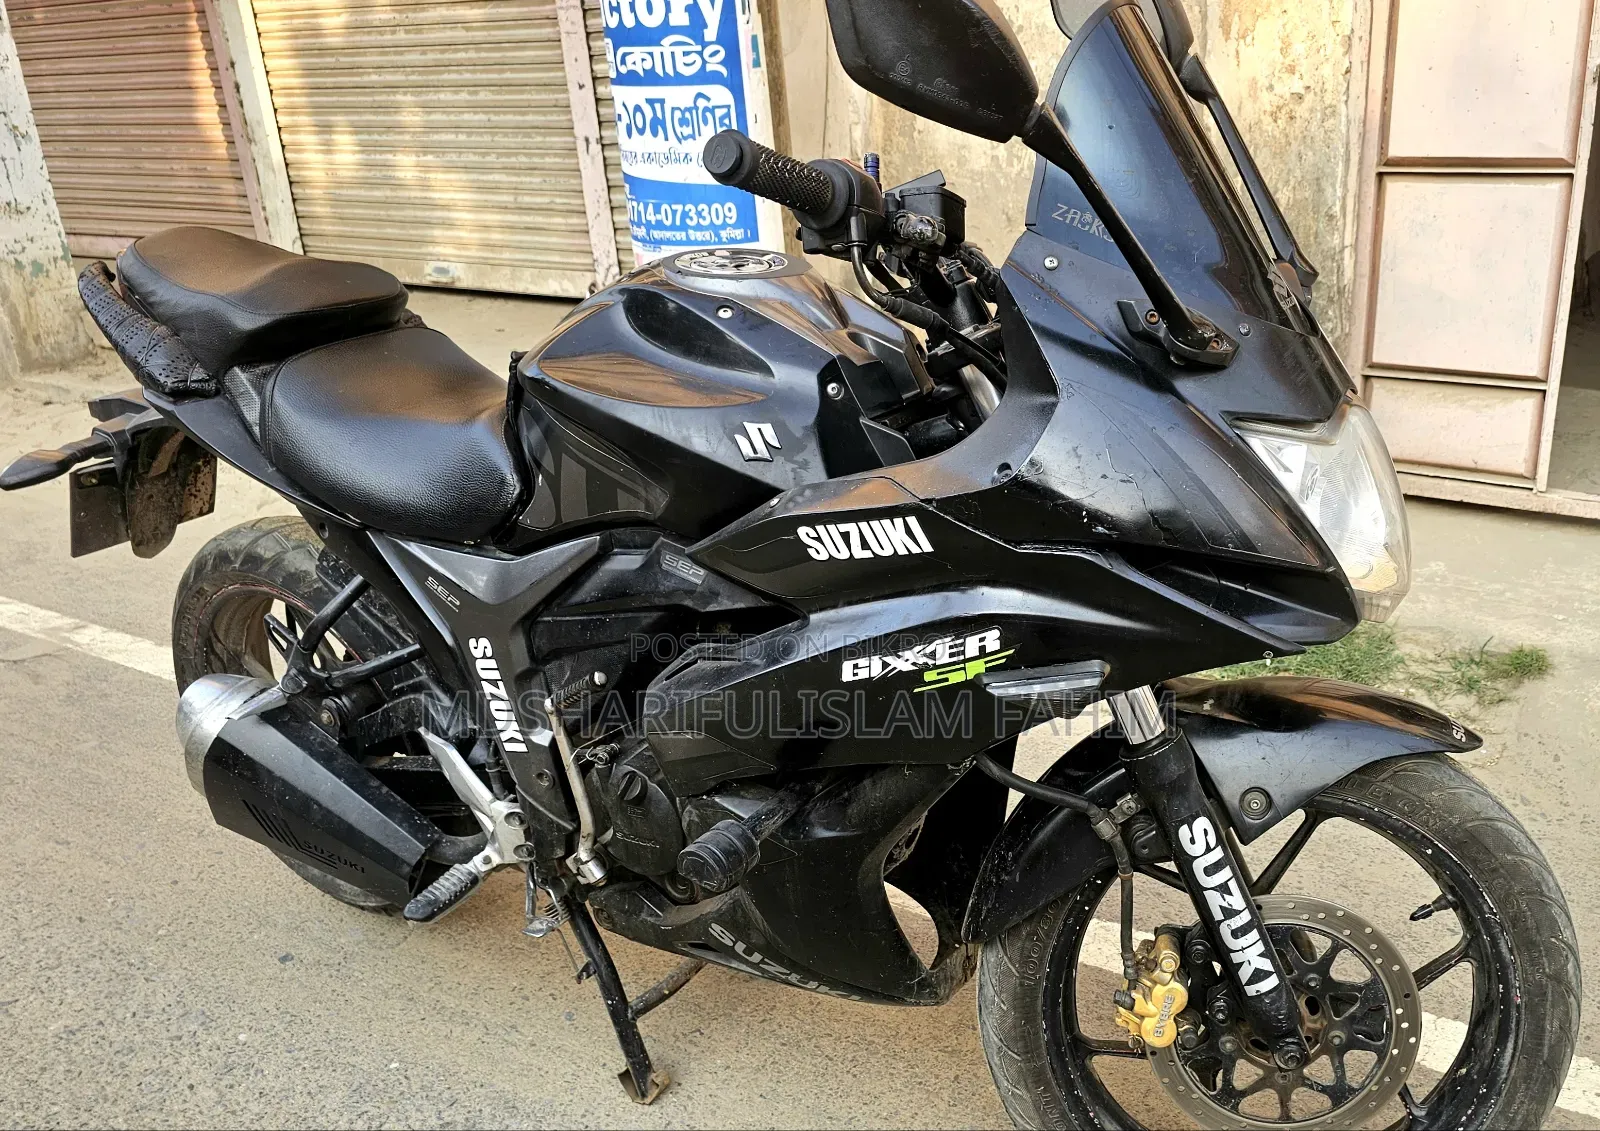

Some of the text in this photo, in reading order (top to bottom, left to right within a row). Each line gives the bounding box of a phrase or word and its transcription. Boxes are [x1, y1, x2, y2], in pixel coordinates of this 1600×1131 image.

[796, 515, 935, 561] SUZUKI
[663, 554, 705, 576] SEP
[426, 576, 460, 606] SEP
[841, 629, 1001, 682] GIXXER
[913, 649, 1015, 692] SF
[468, 637, 528, 753] SUZUKI
[303, 840, 366, 874] SUZUKI
[1178, 816, 1280, 997] SUZUKI
[1153, 993, 1176, 1038] BYBRE
